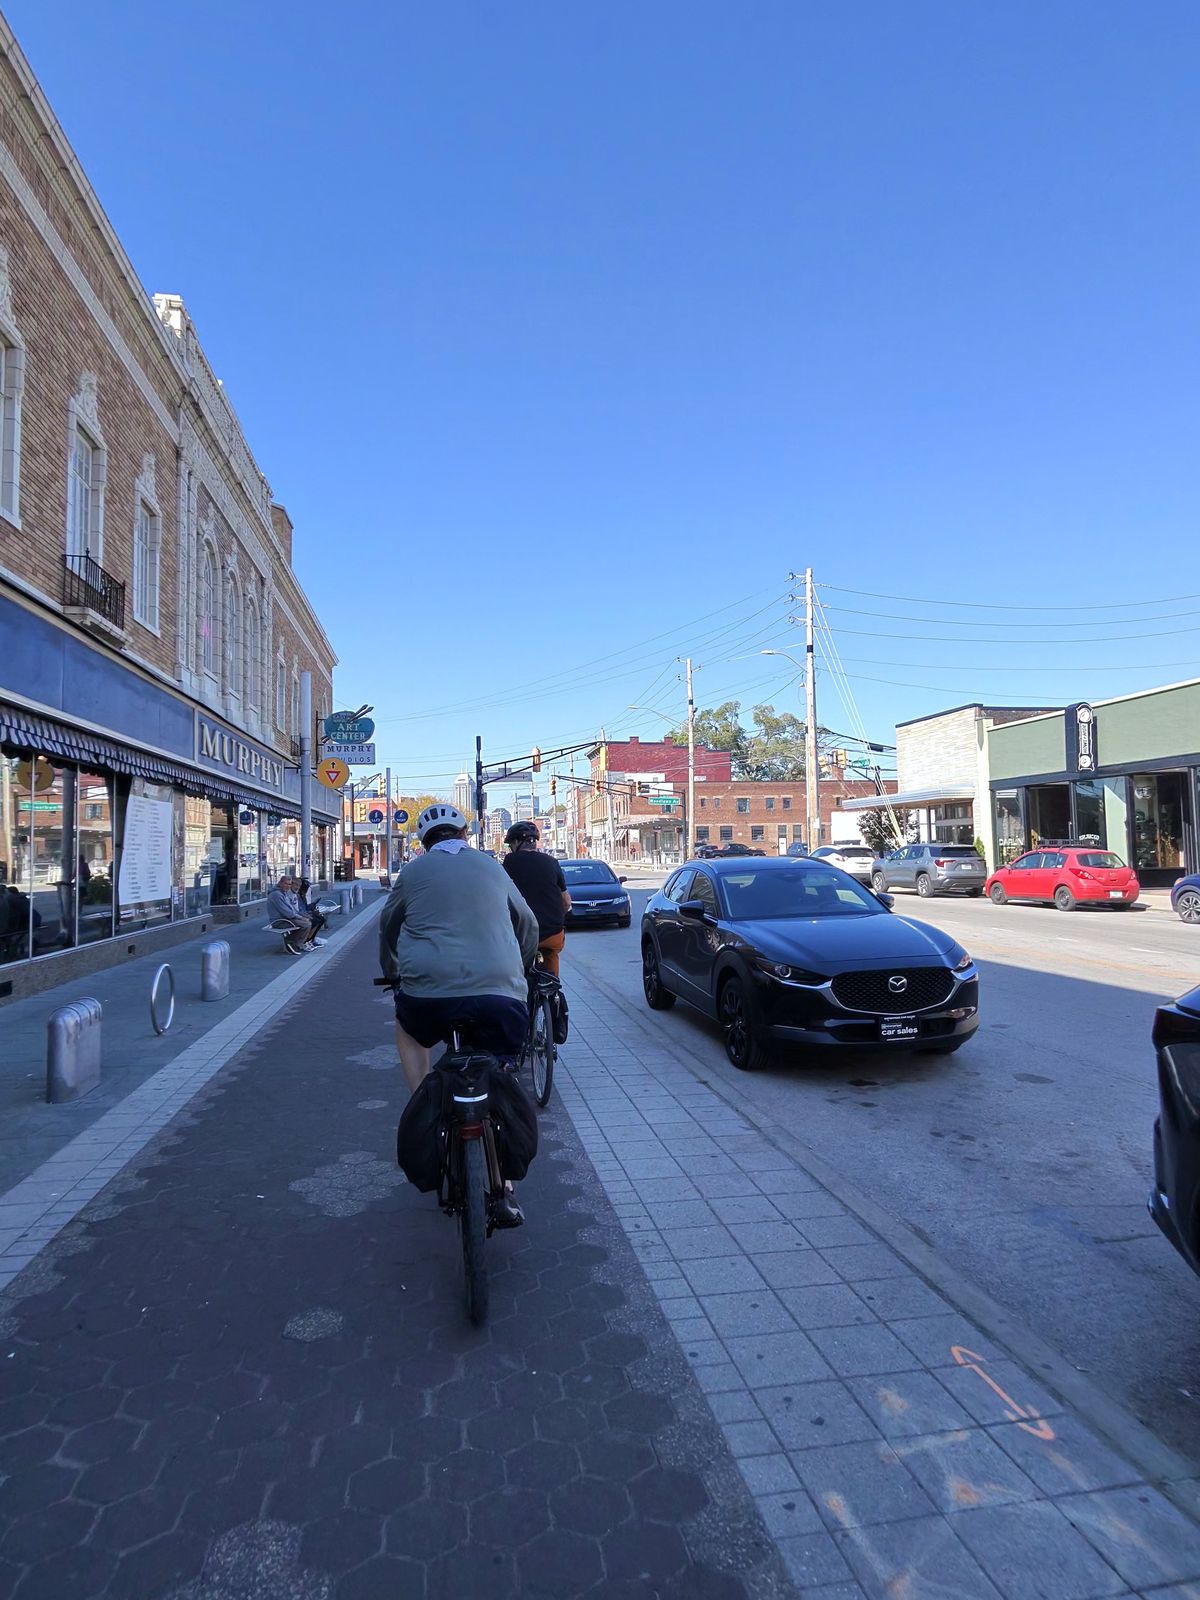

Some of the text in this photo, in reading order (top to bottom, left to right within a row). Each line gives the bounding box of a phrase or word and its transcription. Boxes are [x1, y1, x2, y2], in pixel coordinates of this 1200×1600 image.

[337, 723, 360, 731] ART
[330, 731, 365, 740] CENTER
[327, 745, 372, 753] MURPHY
[201, 722, 281, 786] MURPHY
[897, 1026, 919, 1035] sales
